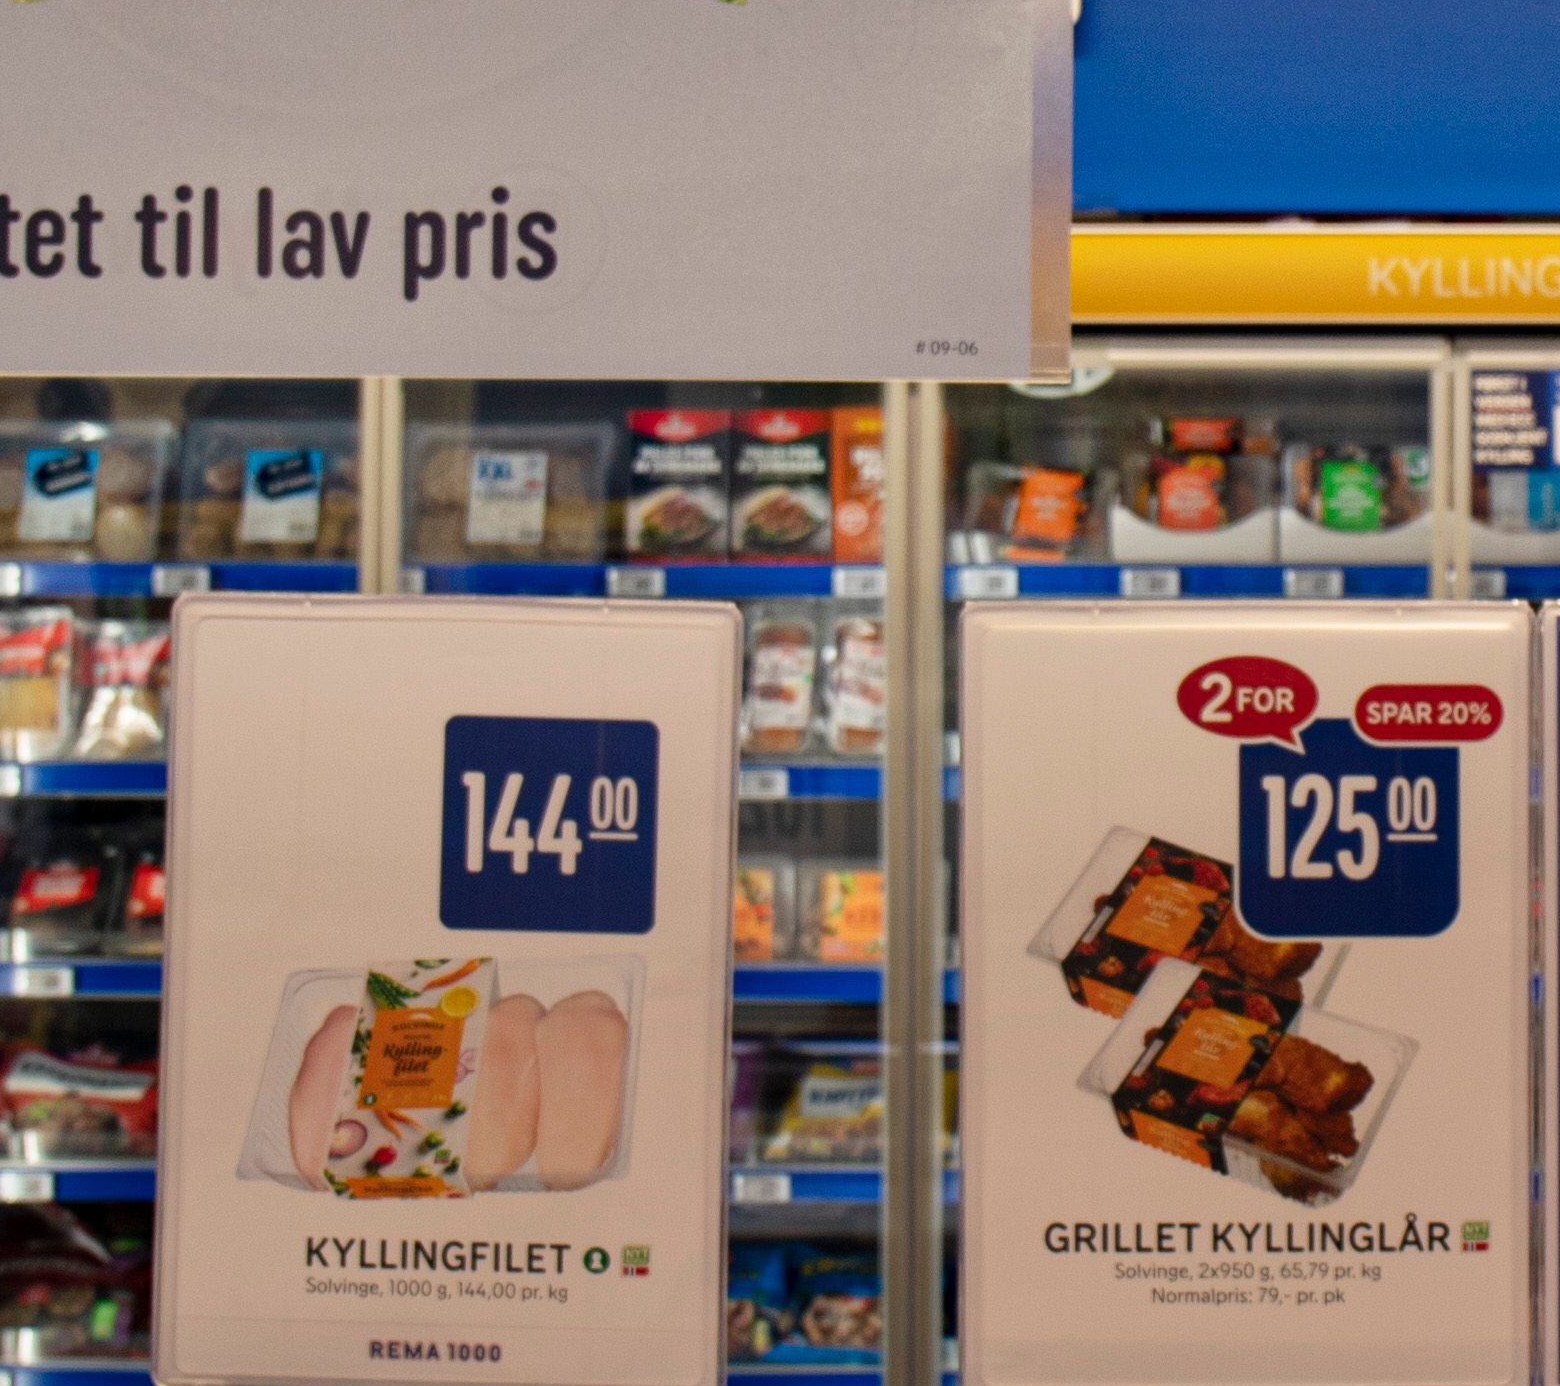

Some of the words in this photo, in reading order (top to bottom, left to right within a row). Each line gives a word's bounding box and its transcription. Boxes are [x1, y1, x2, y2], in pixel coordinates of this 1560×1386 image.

[134, 185, 218, 278] til
[257, 187, 370, 279] lav
[404, 187, 557, 301] pris
[1199, 672, 1233, 723] 2
[1237, 686, 1295, 714] FOR
[1367, 702, 1432, 724] SPAR
[1438, 702, 1491, 724] 20%
[462, 771, 582, 875] 144
[590, 776, 637, 835] 00
[1262, 774, 1379, 880] 125
[1388, 777, 1436, 835] 00
[1044, 1222, 1200, 1253] GRILLET
[1212, 1213, 1450, 1253] KYLLINGLÅR
[306, 1238, 571, 1273] KYLLINGFILET
[306, 1277, 383, 1298] Solvinge,
[390, 1279, 432, 1297] 1000
[437, 1284, 451, 1300] g,
[458, 1281, 516, 1300] 144,00
[521, 1287, 542, 1301] pr.
[548, 1285, 568, 1303] kg
[1115, 1262, 1193, 1282] Solvinge,
[1199, 1262, 1255, 1279] 2x950
[1259, 1266, 1274, 1288] g,
[1279, 1262, 1329, 1280] 65,79
[1334, 1266, 1355, 1281] pr.
[1361, 1263, 1381, 1281] kg
[1151, 1281, 1252, 1306] Normalpris:
[1259, 1286, 1290, 1305] 79,-
[1297, 1291, 1318, 1305] pr.
[1323, 1288, 1344, 1305] pk
[369, 1341, 439, 1360] REMA
[447, 1343, 501, 1362] 1000
